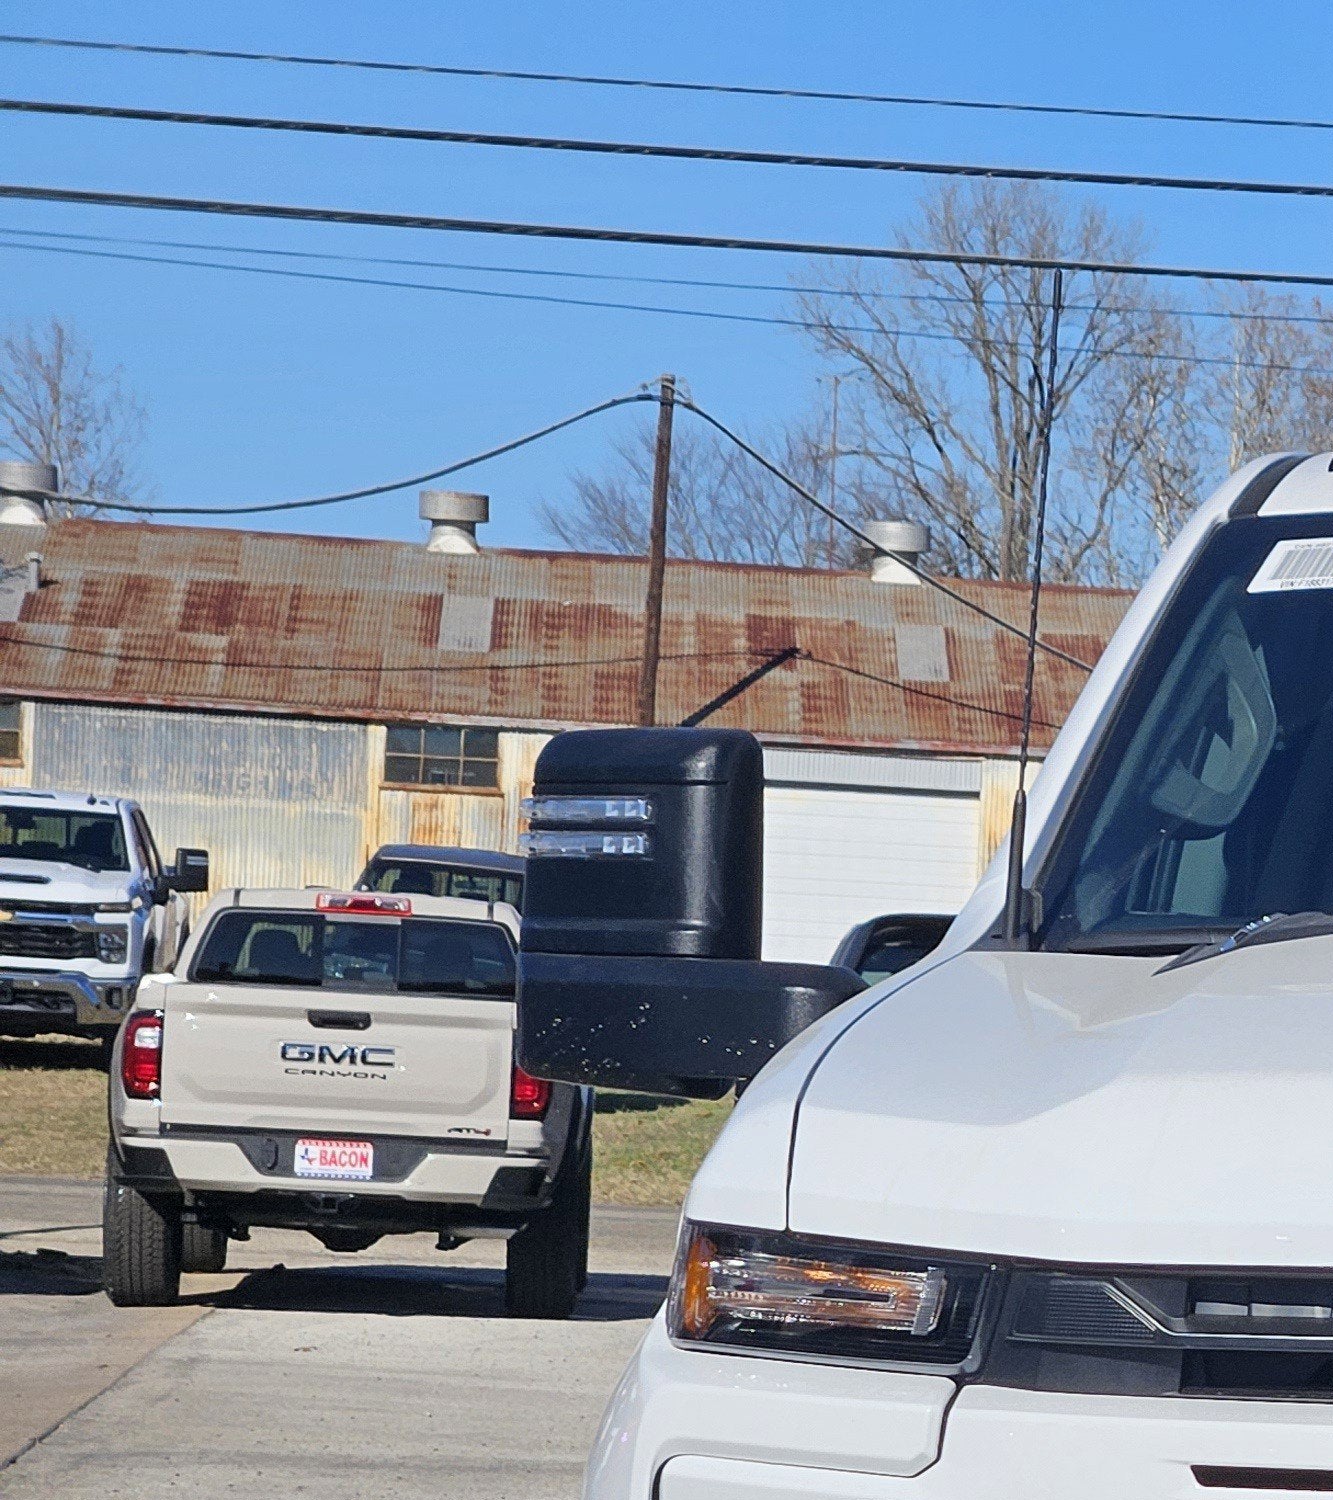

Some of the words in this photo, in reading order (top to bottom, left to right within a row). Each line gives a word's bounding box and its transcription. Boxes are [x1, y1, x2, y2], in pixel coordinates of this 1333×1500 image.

[280, 1042, 396, 1069] GMC
[285, 1068, 387, 1080] CANYON
[319, 1149, 370, 1169] BACON
